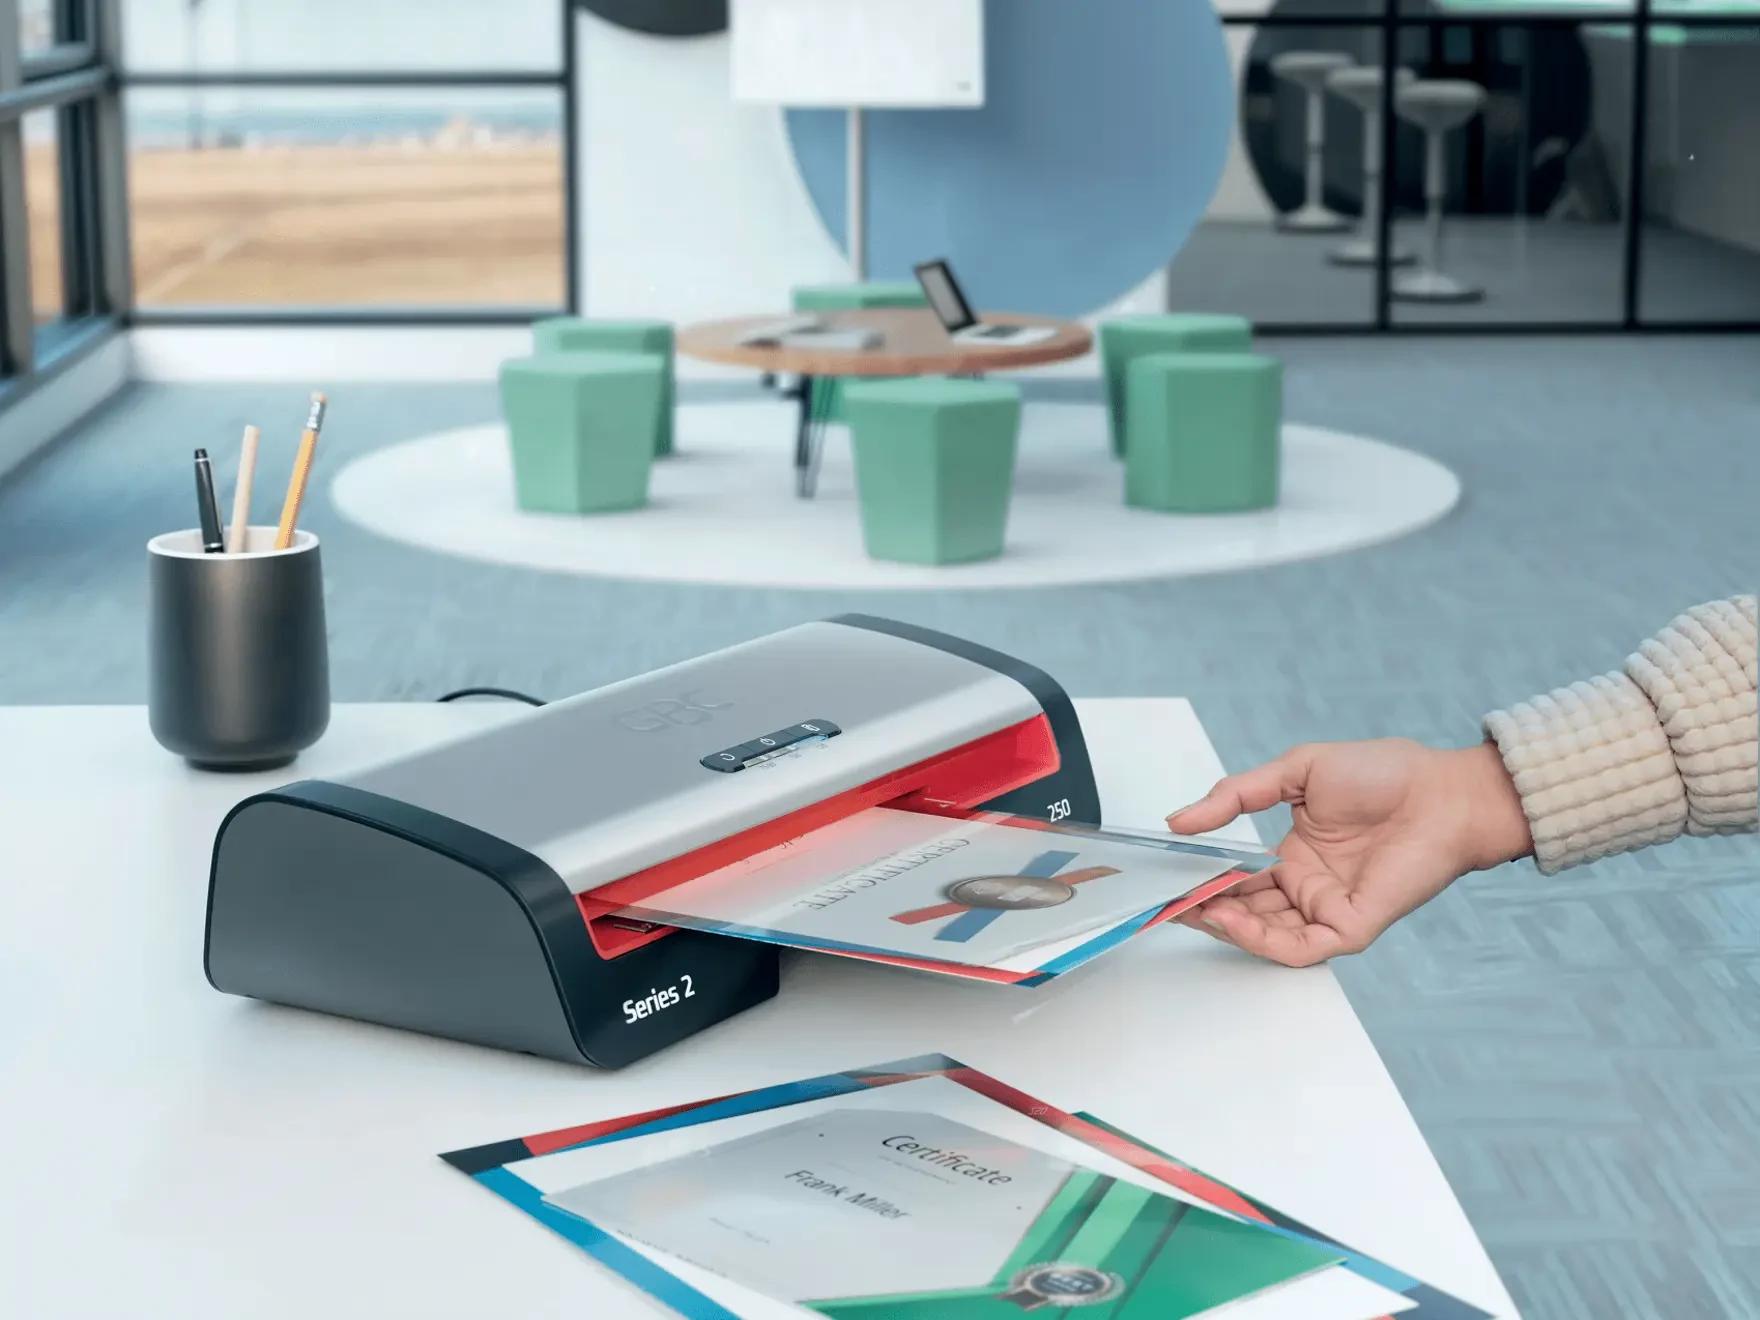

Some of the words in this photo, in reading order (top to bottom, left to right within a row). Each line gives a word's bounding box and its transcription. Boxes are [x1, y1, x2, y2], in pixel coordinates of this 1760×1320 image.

[1046, 798, 1071, 823] 250
[793, 837, 971, 911] CERTIFICATE
[622, 985, 680, 1024] Series
[680, 974, 696, 999] 2
[881, 1134, 1012, 1186] Certificate
[783, 1168, 848, 1198] Frank
[845, 1192, 911, 1219] Miller
